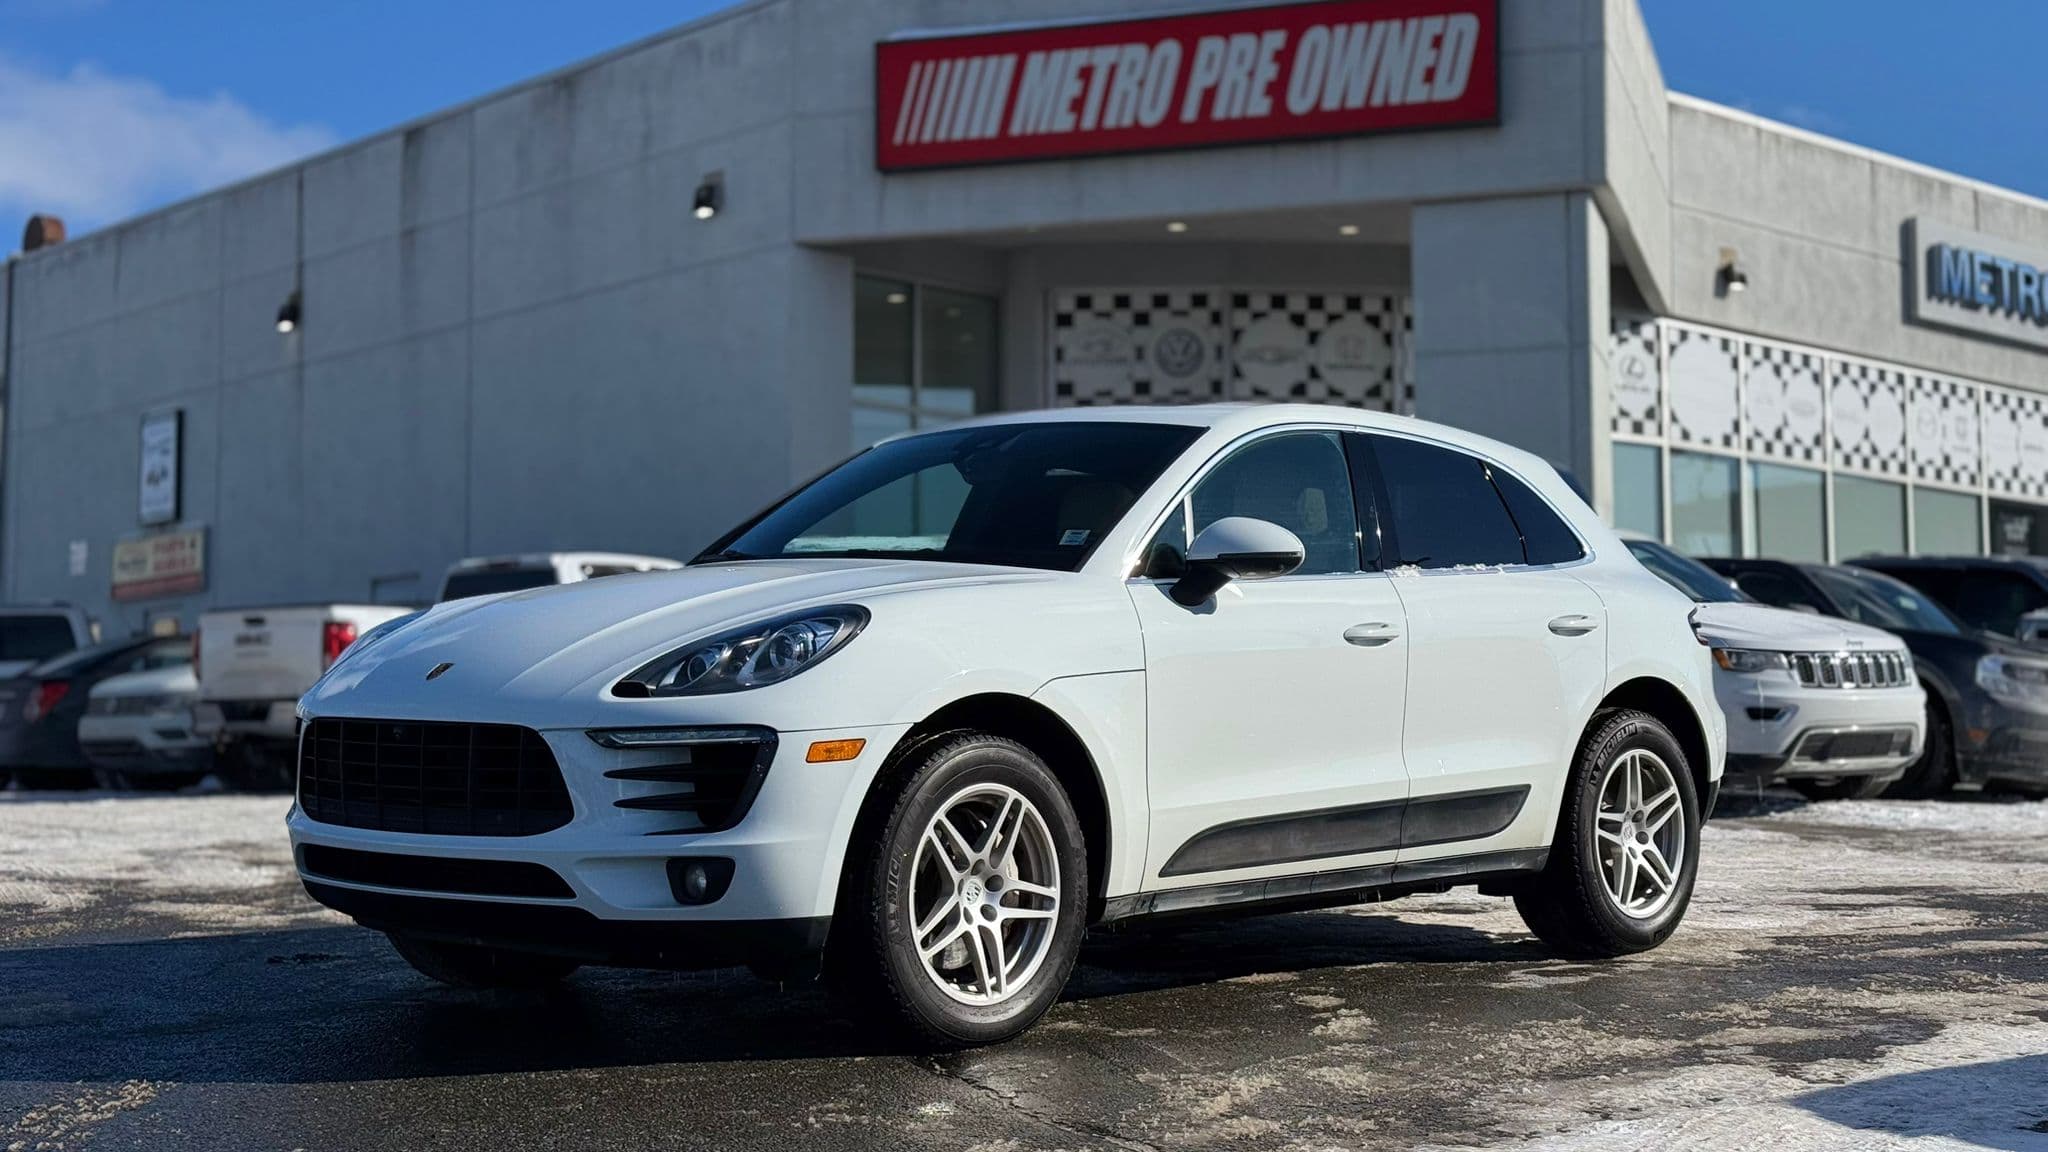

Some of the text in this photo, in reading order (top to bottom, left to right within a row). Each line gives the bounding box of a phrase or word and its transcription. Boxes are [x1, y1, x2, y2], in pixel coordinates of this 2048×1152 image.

[1008, 12, 1480, 137] METRO PRE OWNED
[1936, 243, 2048, 323] METR
[1596, 723, 1637, 769] MICHELIN
